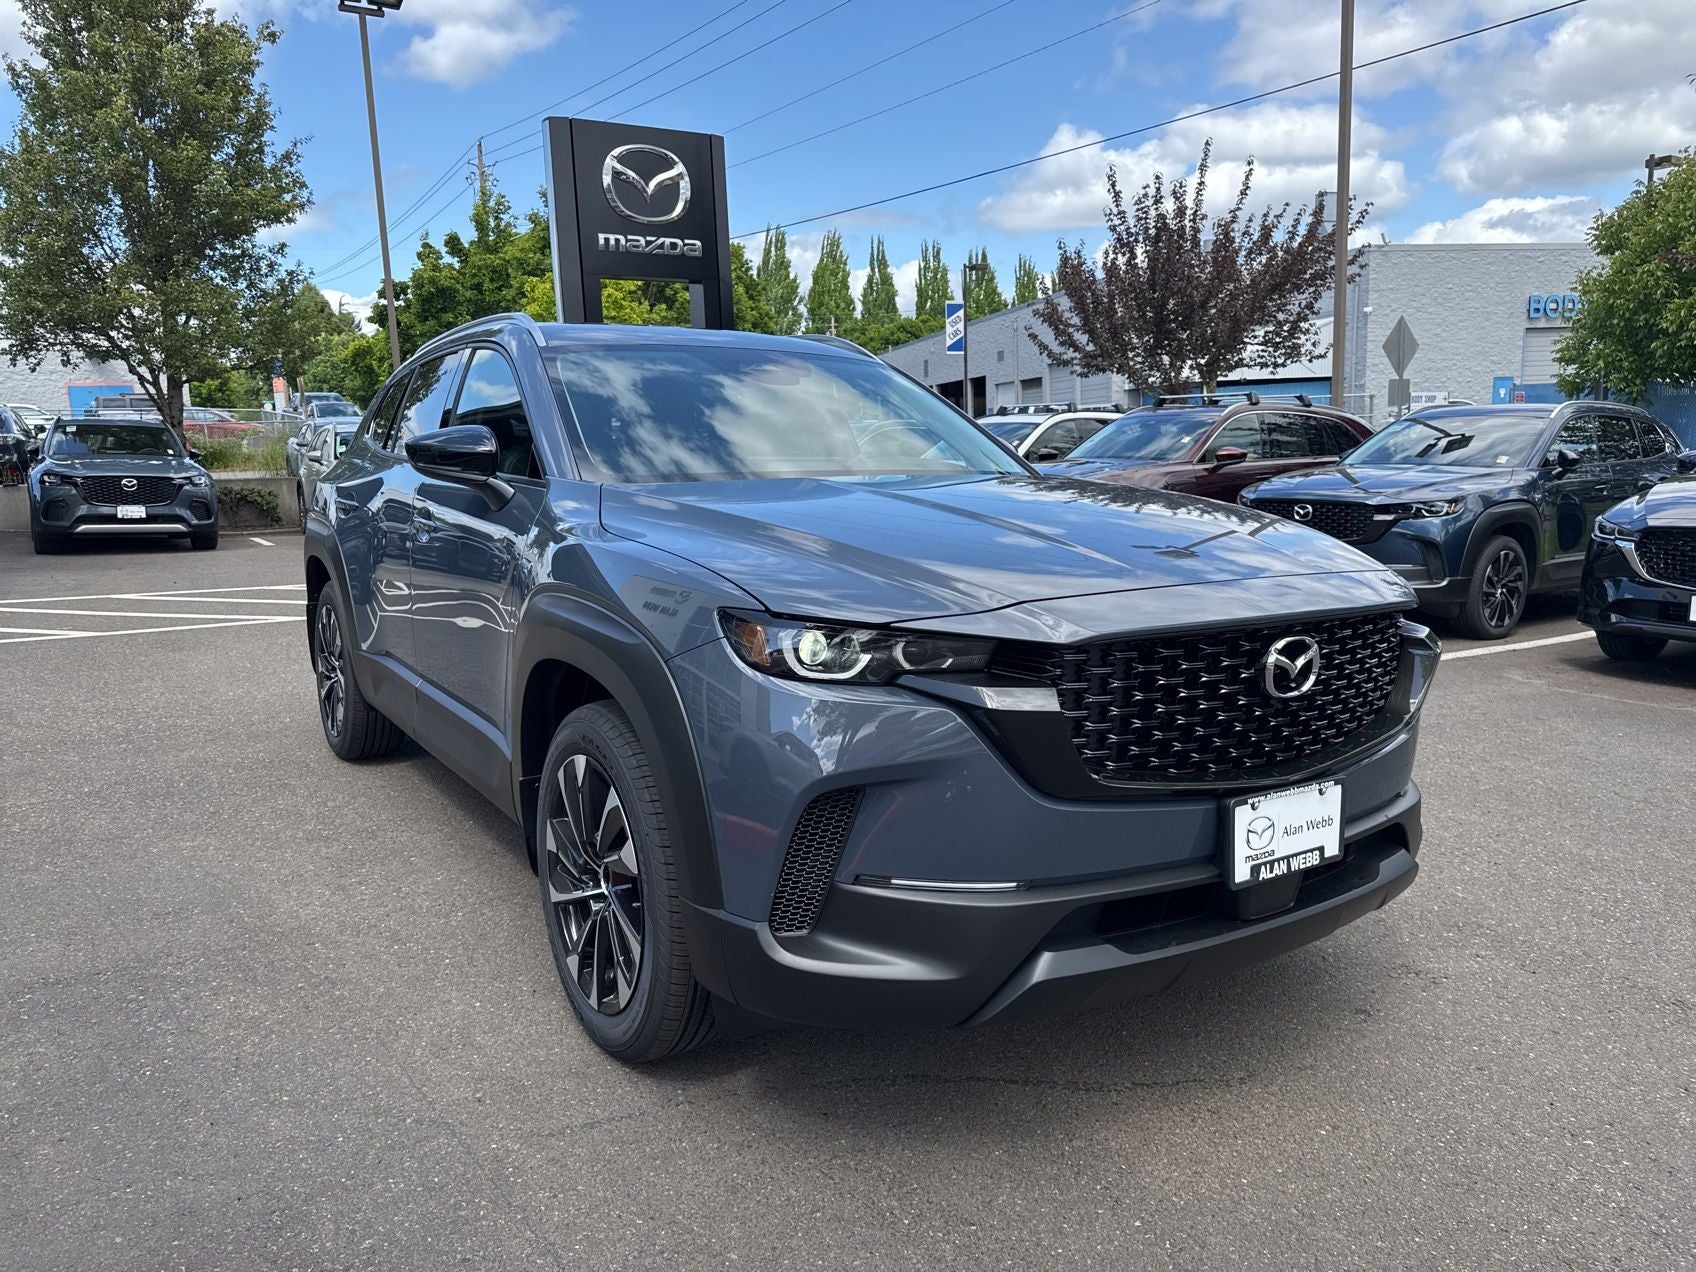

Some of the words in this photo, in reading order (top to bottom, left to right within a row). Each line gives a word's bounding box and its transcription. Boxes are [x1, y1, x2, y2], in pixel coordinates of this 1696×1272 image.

[1528, 294, 1585, 319] BOD
[948, 315, 963, 328] USED
[948, 327, 962, 341] CARS
[1247, 780, 1335, 805] www.alanwebbmazda.com
[1281, 823, 1304, 839] Alan
[1305, 814, 1334, 832] Webb
[1244, 849, 1276, 864] mazda
[1258, 859, 1288, 881] ALAN
[1289, 850, 1321, 872] WEBB
